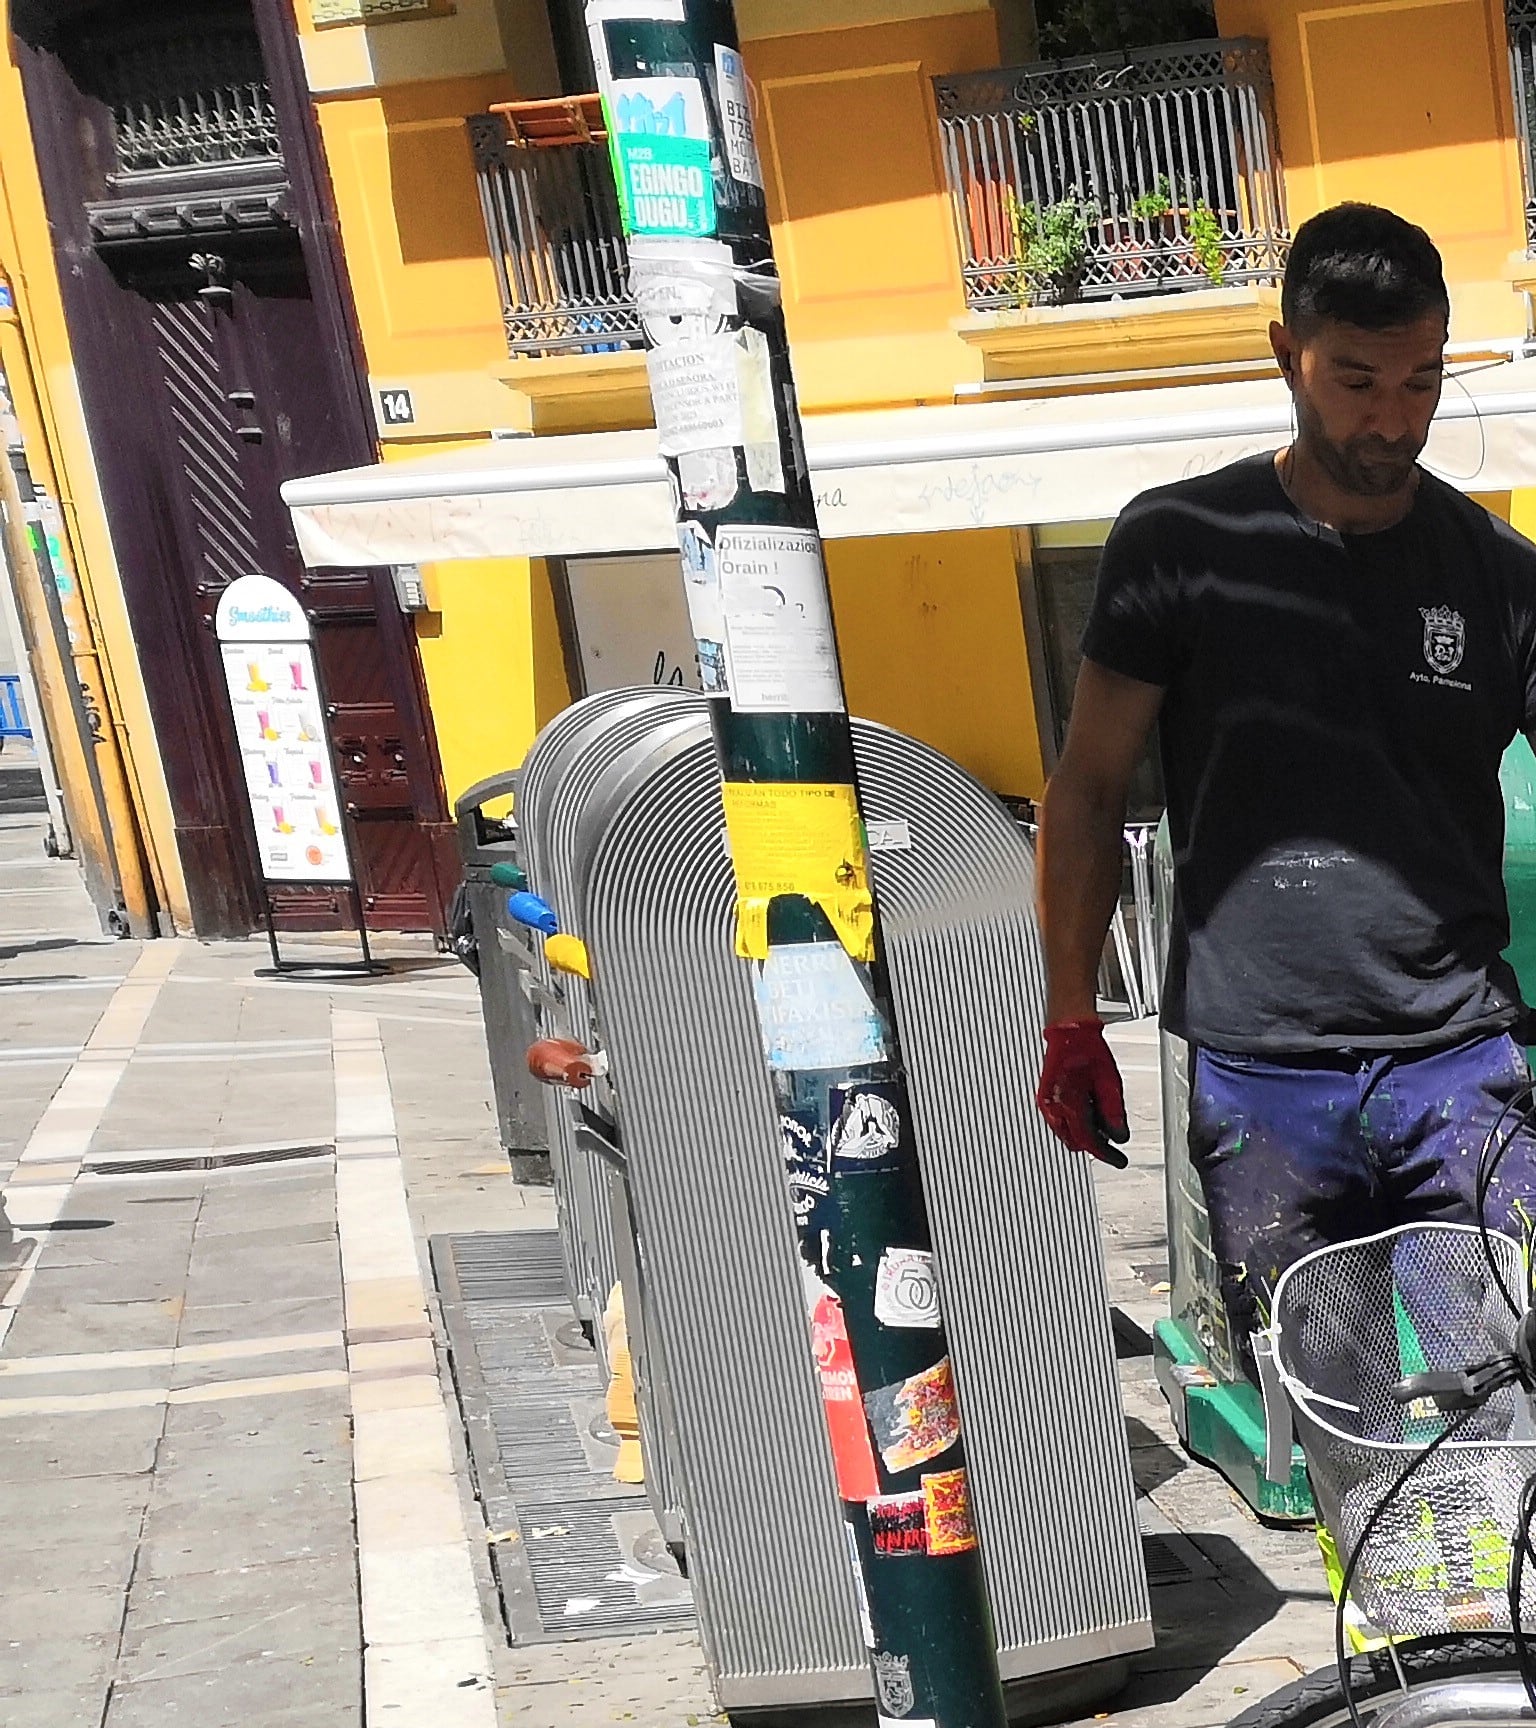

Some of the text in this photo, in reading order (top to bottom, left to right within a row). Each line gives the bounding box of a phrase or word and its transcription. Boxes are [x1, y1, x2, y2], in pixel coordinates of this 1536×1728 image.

[629, 163, 704, 197] EGINGO
[384, 394, 410, 420] 14
[722, 561, 768, 575] Orain
